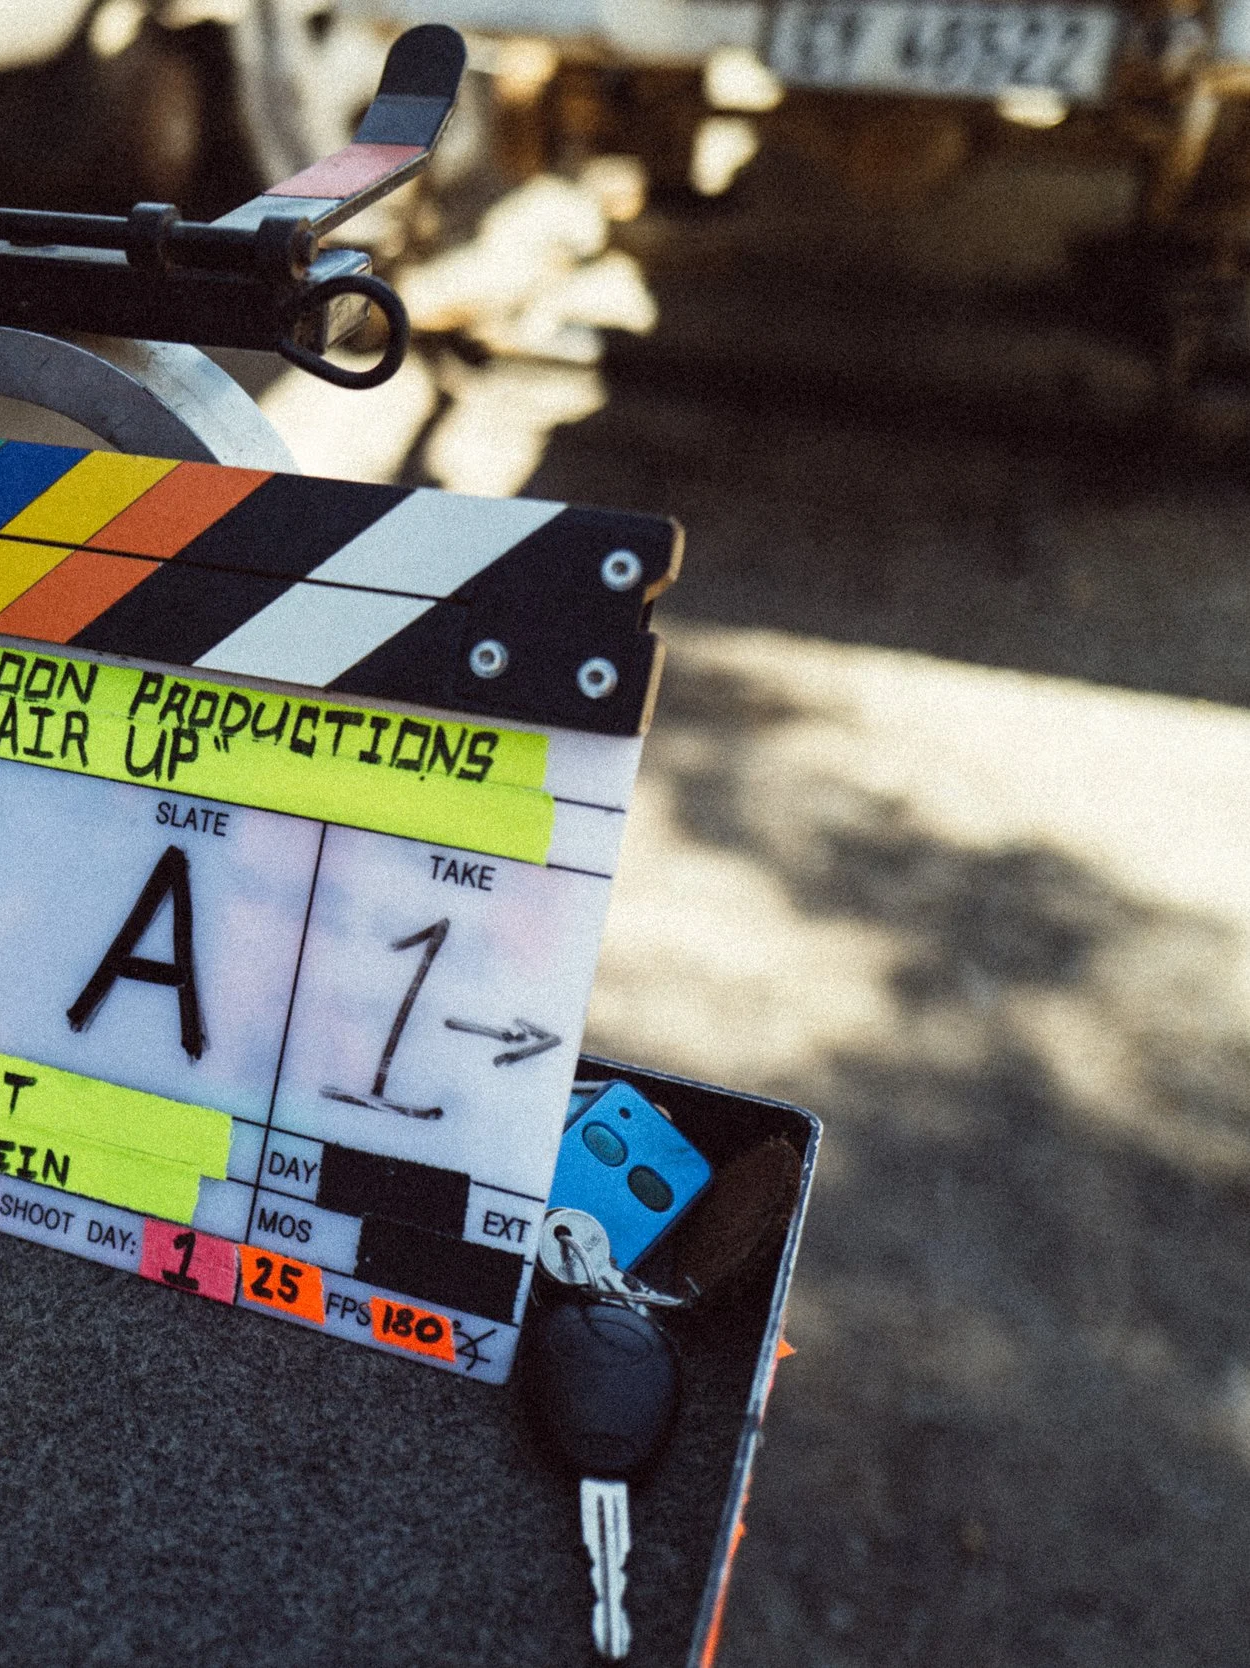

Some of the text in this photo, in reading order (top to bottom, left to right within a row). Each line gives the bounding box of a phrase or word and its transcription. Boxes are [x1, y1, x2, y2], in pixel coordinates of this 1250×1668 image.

[127, 671, 500, 782] PRODUCTIONS
[123, 724, 231, 783] UP"
[155, 801, 230, 838] SLATE
[429, 855, 497, 892] TAKE
[66, 844, 210, 1061] A
[319, 916, 452, 1120] 1
[268, 1150, 318, 1185] DAY
[86, 1221, 137, 1257] DAY:
[257, 1207, 313, 1244] MOS
[482, 1210, 532, 1244] EXT
[160, 1231, 200, 1291] 1
[249, 1256, 305, 1304] 25
[325, 1292, 371, 1328] FPS
